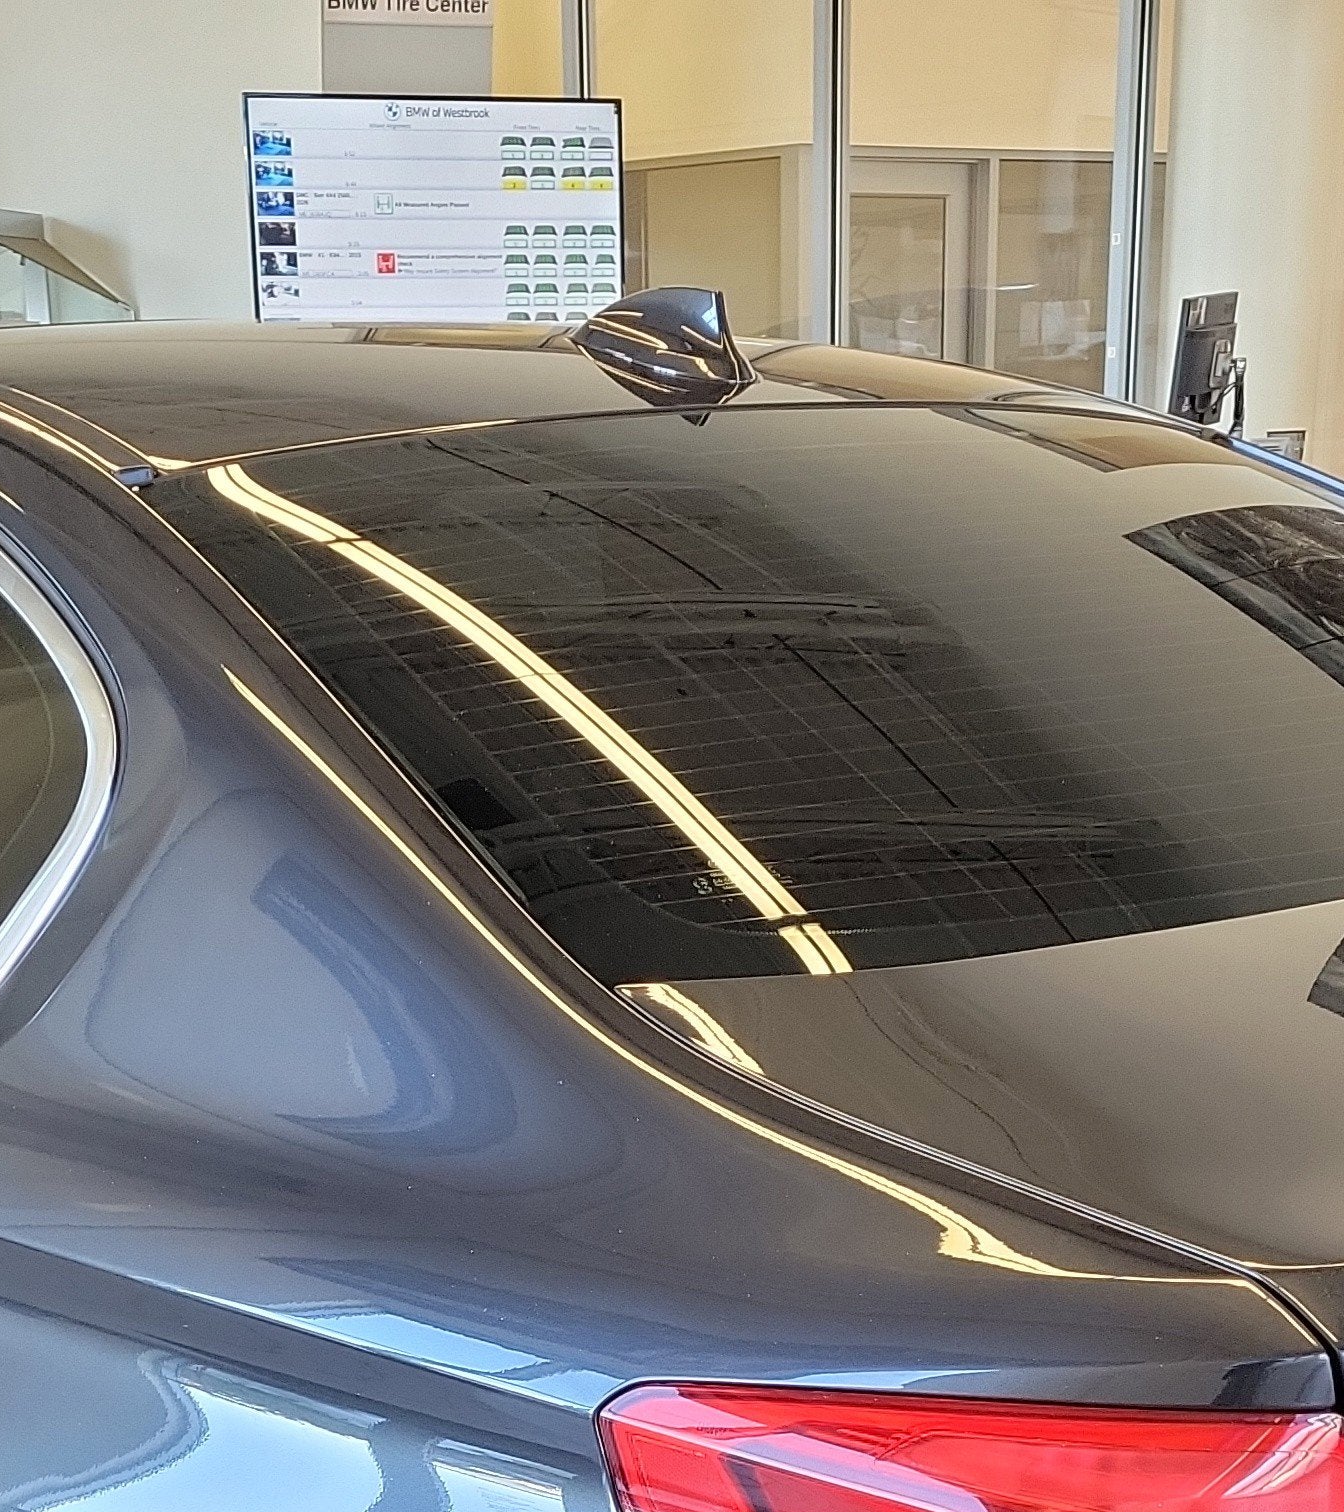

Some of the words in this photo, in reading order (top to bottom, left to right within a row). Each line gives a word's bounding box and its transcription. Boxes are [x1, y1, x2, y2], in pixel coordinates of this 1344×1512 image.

[328, 0, 377, 10] BMW
[385, 0, 420, 11] Tire
[425, 0, 489, 13] Center
[405, 106, 430, 117] BMW
[432, 107, 441, 118] of
[443, 107, 490, 118] Westbrook
